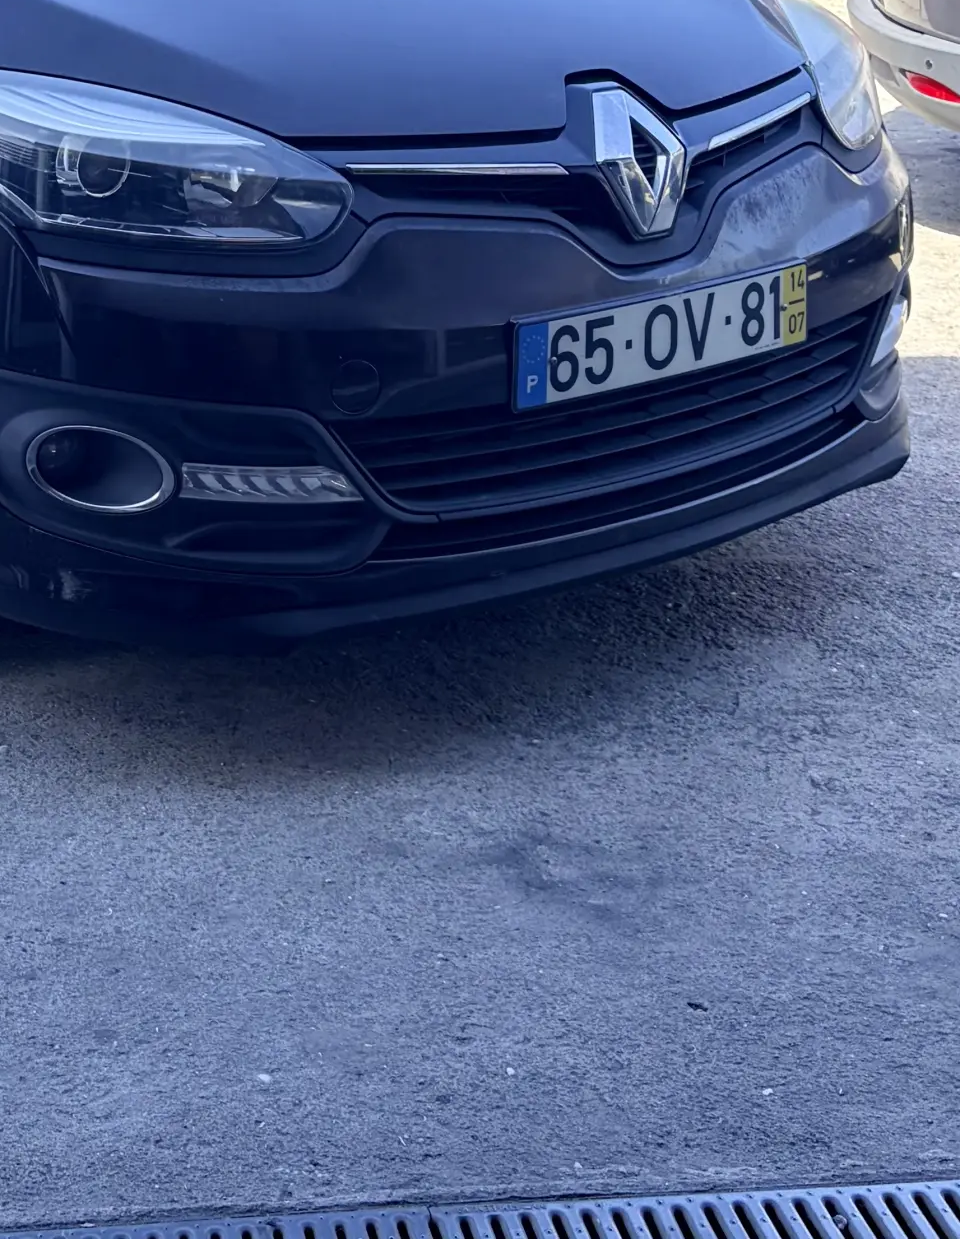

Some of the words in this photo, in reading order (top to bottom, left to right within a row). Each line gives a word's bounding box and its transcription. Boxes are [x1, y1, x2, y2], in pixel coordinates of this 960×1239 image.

[790, 268, 805, 292] 14
[788, 311, 805, 335] 07
[526, 374, 539, 394] P
